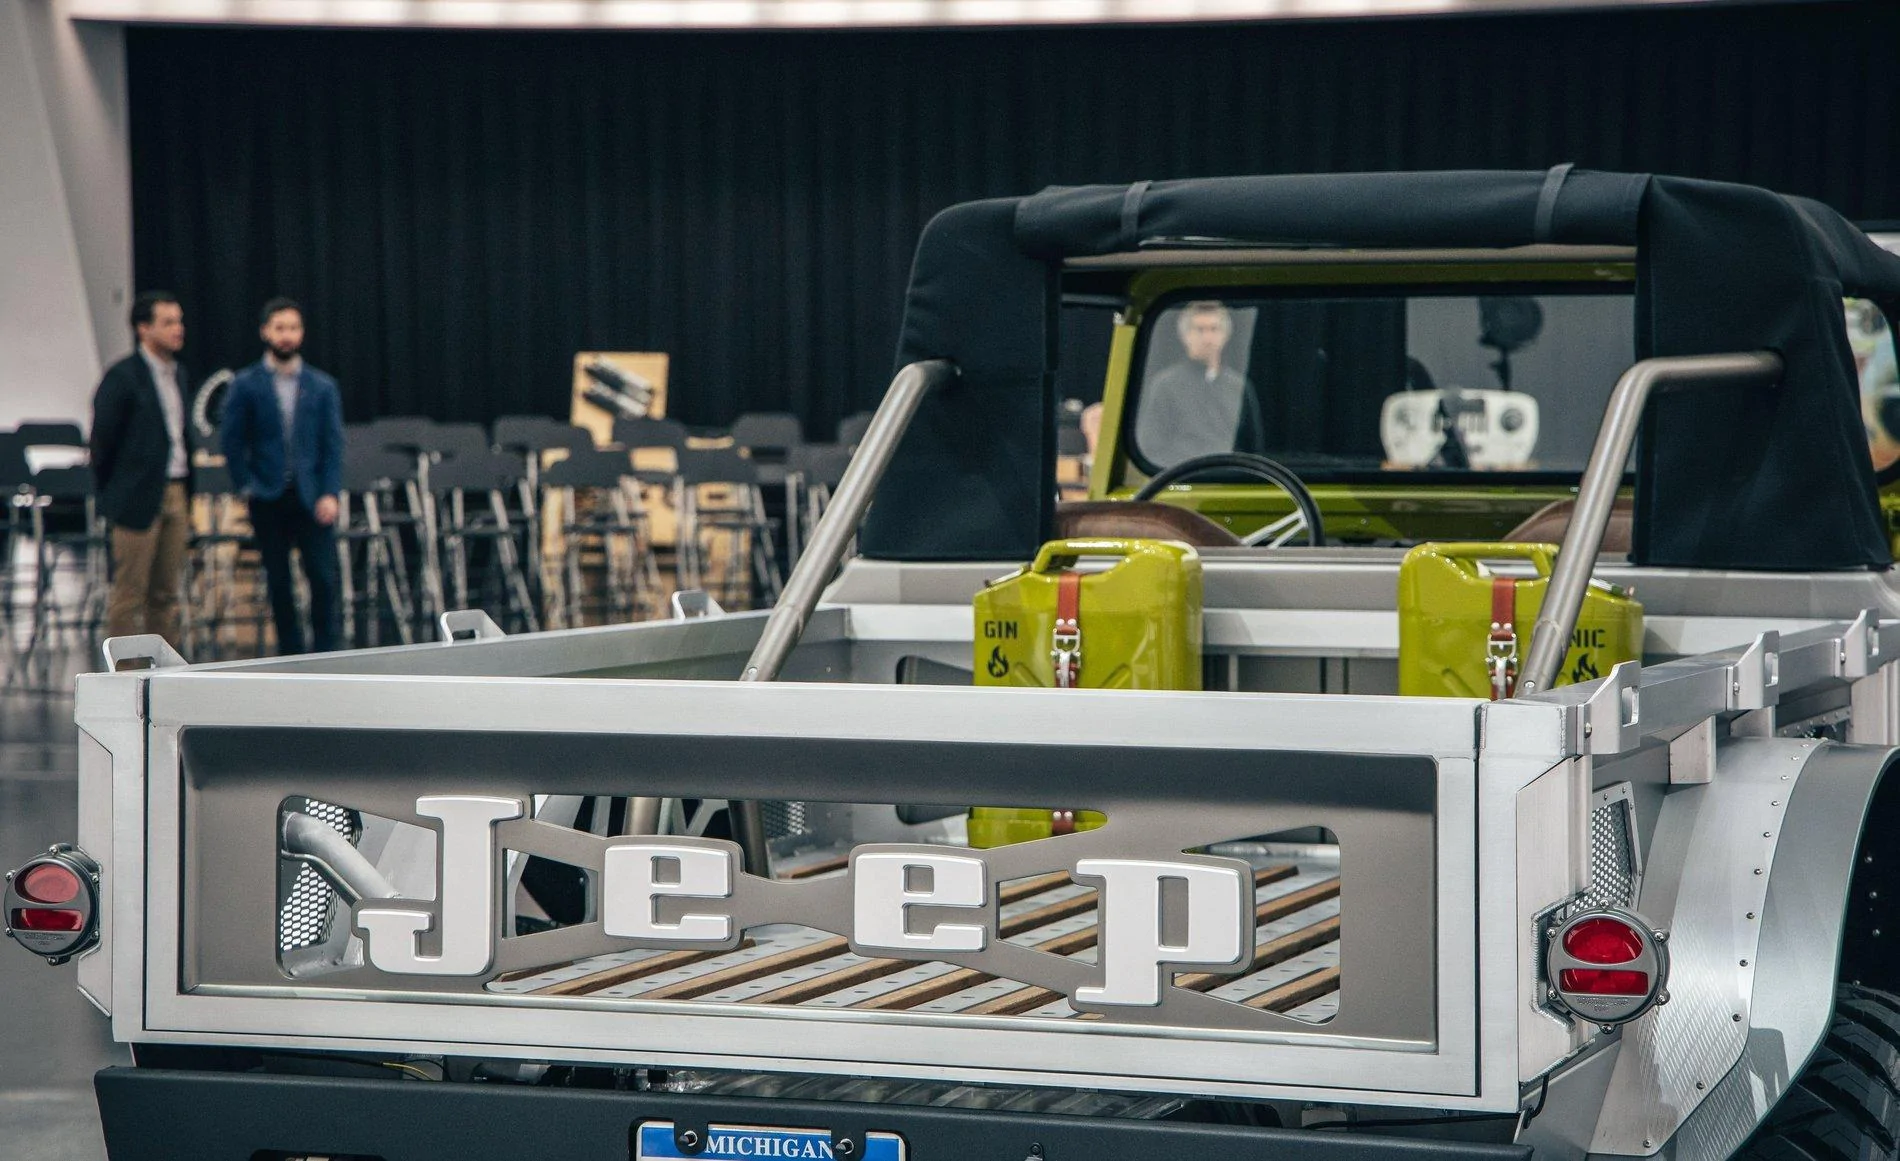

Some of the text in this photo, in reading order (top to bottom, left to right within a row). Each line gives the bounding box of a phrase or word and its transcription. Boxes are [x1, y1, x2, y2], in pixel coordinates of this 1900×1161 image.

[985, 621, 1018, 639] GIN
[1569, 629, 1605, 648] NIC
[357, 796, 1243, 1008] Jeep
[705, 1135, 834, 1159] MICHIGAN
